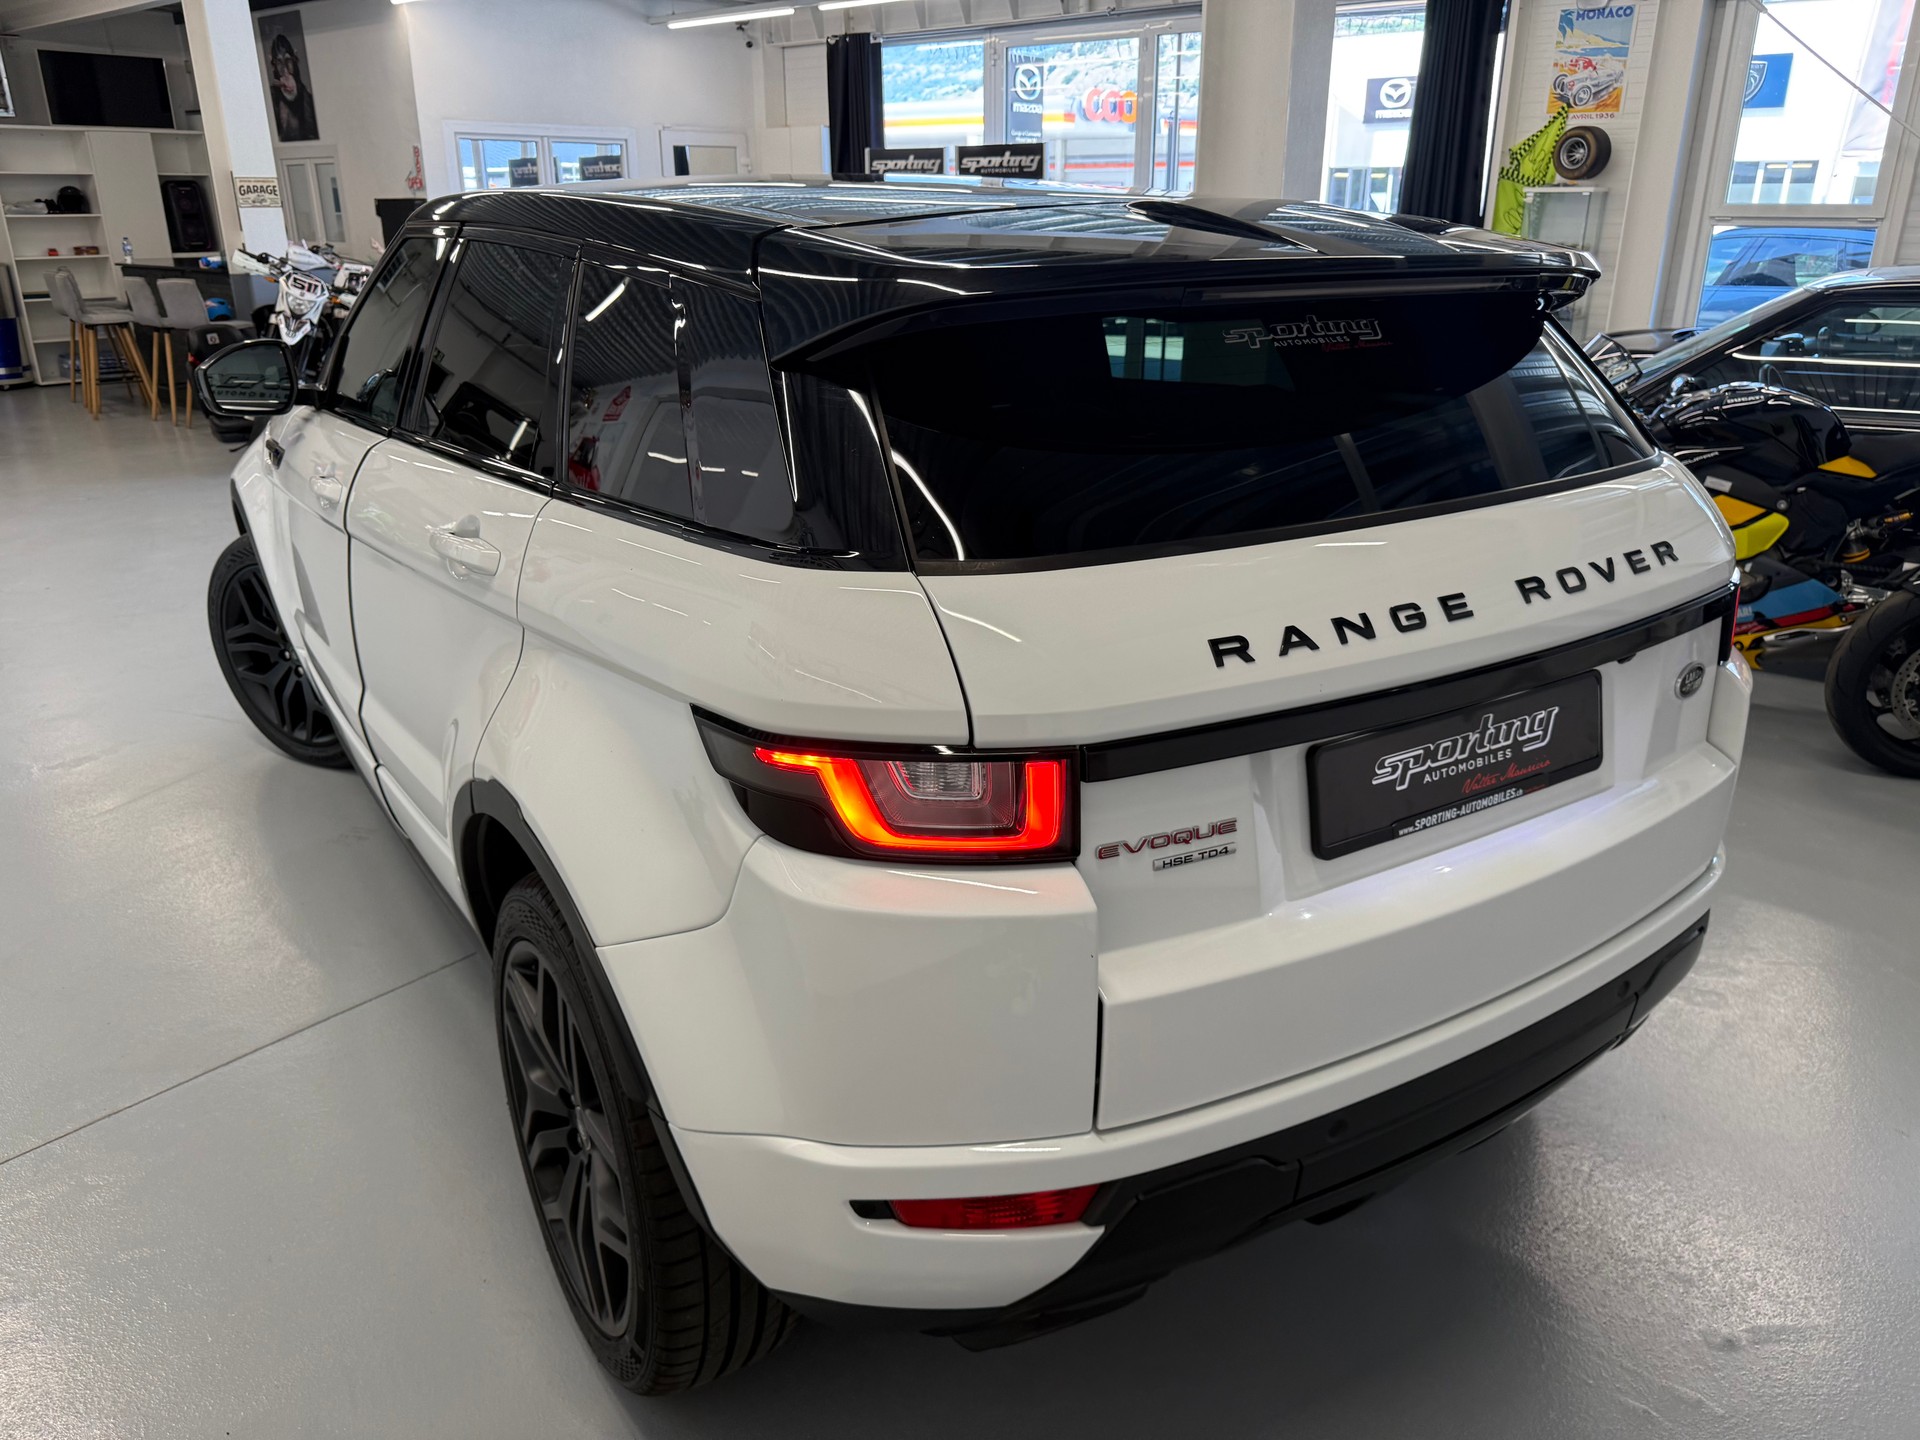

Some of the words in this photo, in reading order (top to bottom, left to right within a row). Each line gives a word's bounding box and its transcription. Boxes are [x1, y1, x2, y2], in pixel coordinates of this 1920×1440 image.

[1575, 6, 1634, 21] MONACO
[871, 154, 941, 174] sporting
[960, 150, 1041, 173] sporting
[238, 184, 279, 197] GARAGE
[1222, 314, 1383, 349] sporting
[1273, 335, 1351, 348] AUTOMOBILES
[1726, 395, 1765, 405] DUCATI
[1206, 592, 1475, 669] RANGE
[1513, 540, 1680, 605] ROVER
[1371, 705, 1560, 791] sporting
[1423, 748, 1513, 784] AUTOMOBILES
[1397, 787, 1524, 837] www.SPORTING-AUTOMOBILES.ch
[1095, 817, 1238, 860] EVOQUE
[1162, 854, 1194, 869] HSE
[1197, 846, 1230, 860] TD4
